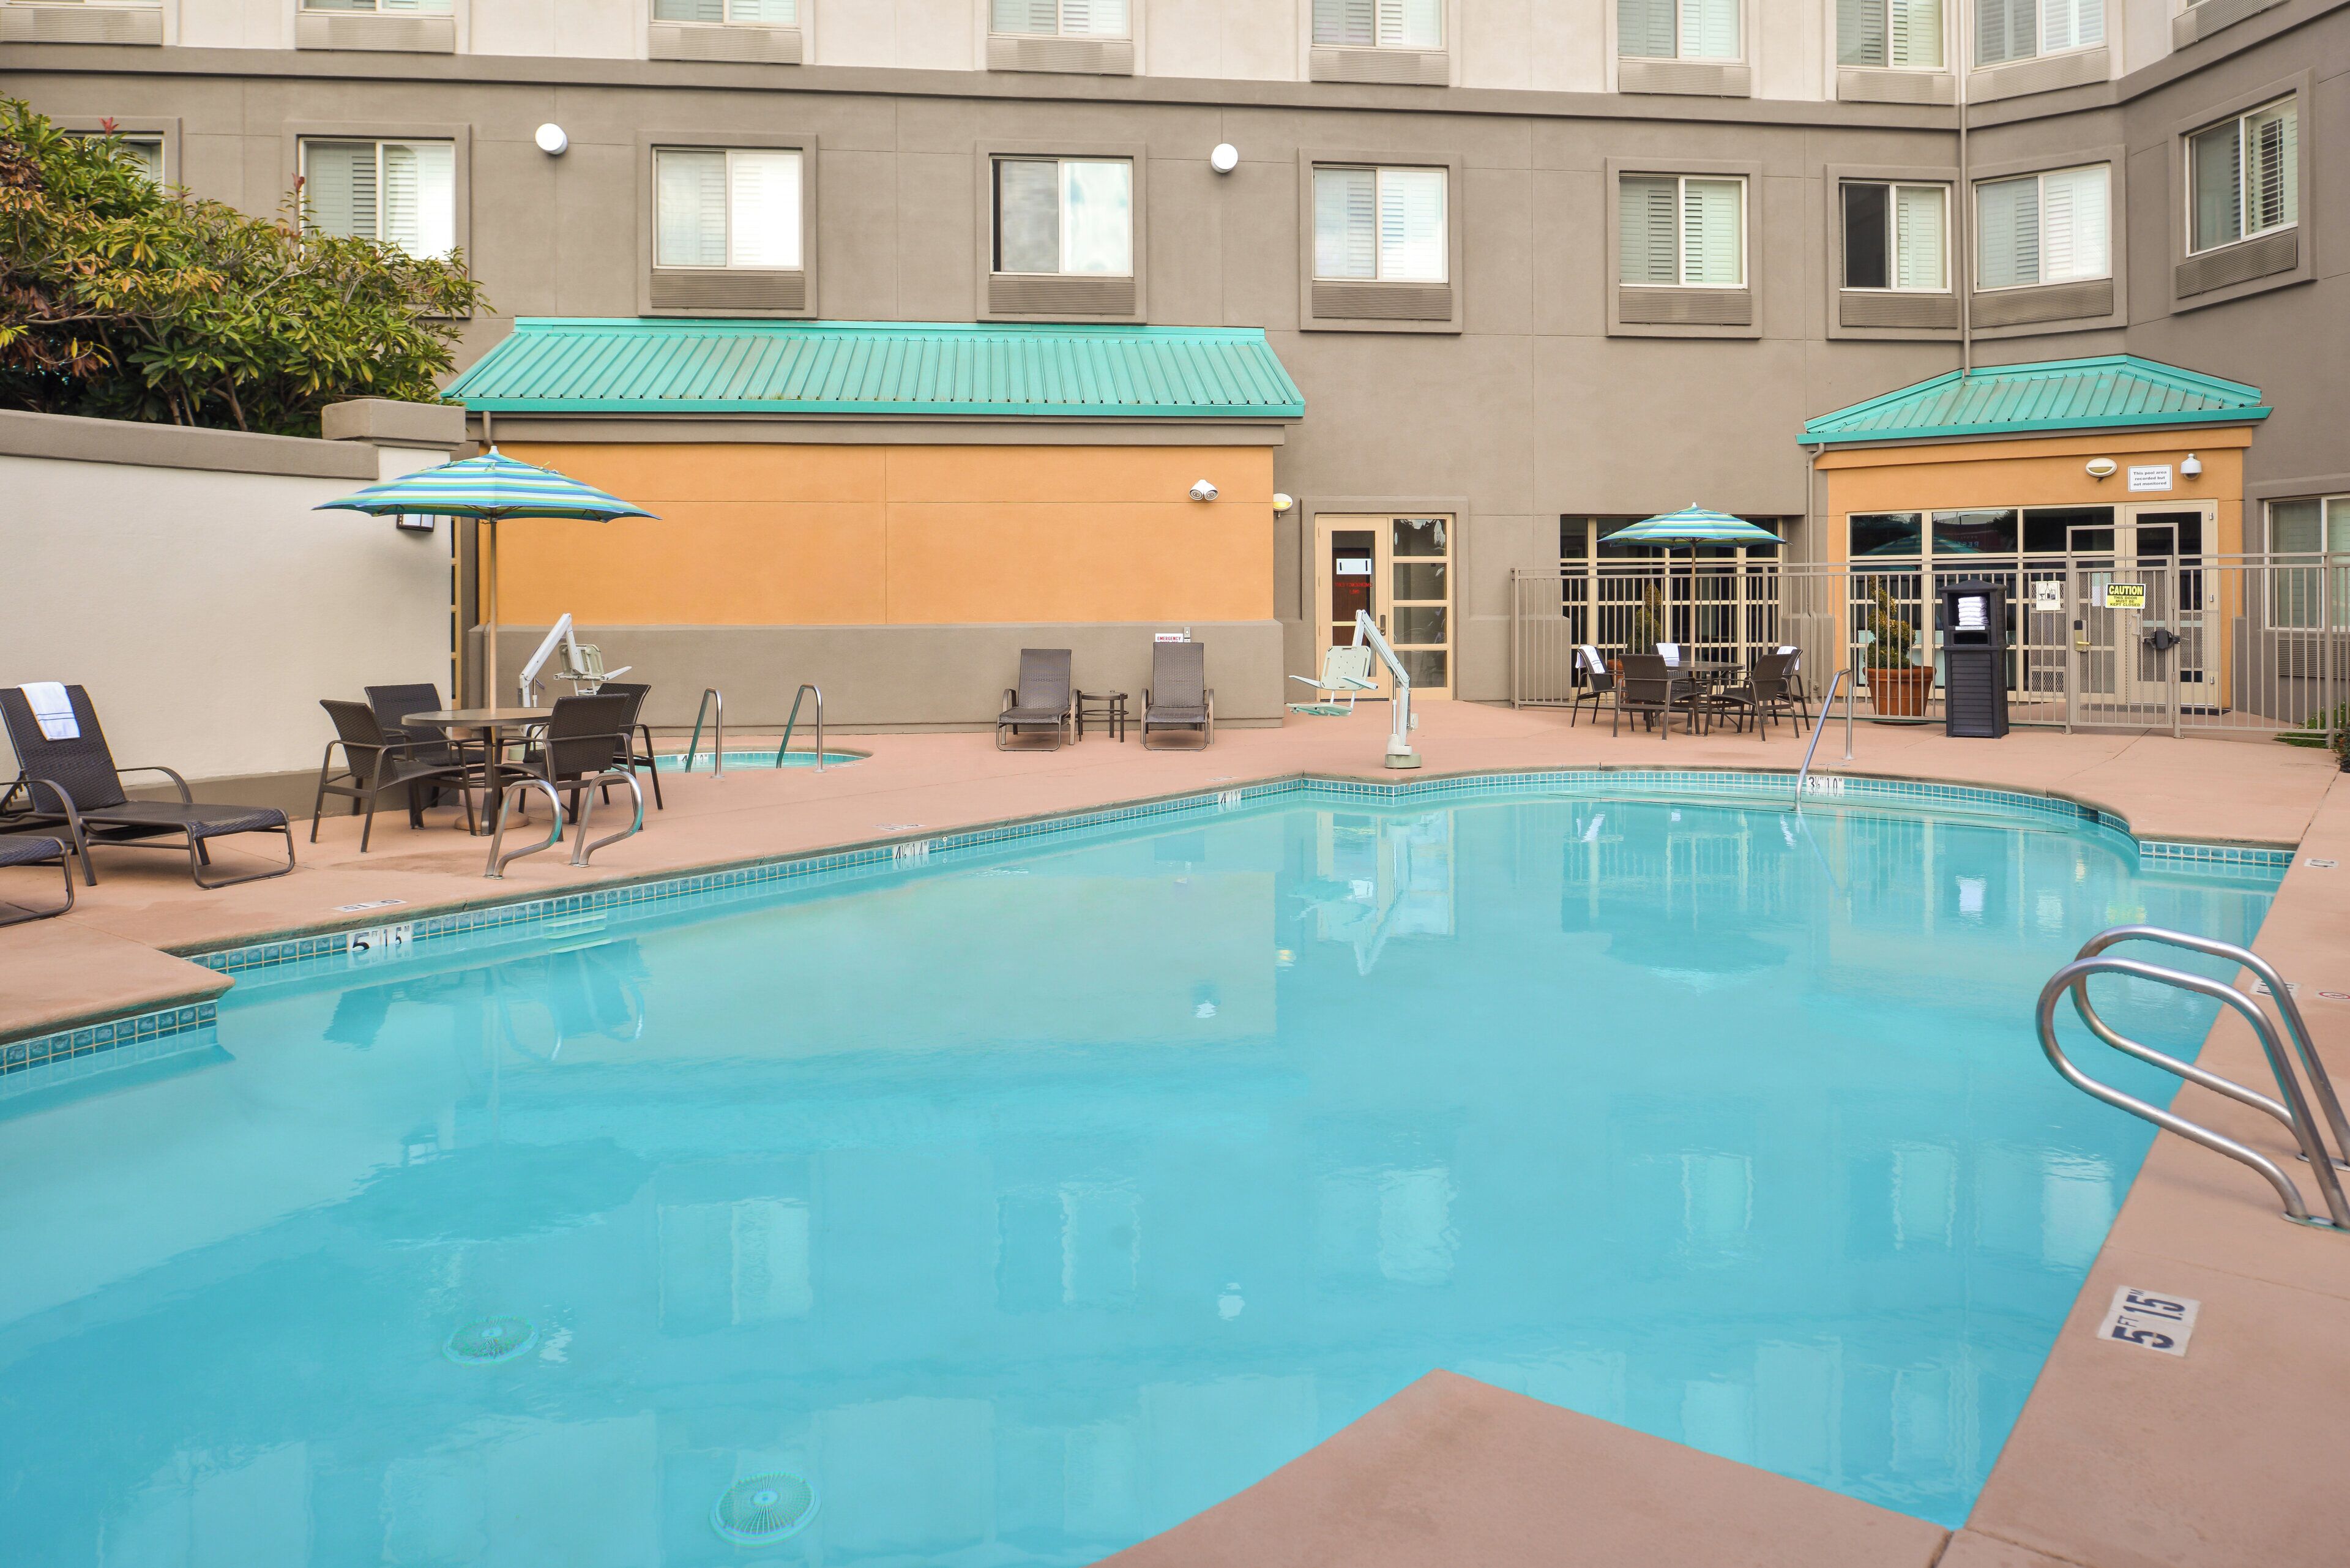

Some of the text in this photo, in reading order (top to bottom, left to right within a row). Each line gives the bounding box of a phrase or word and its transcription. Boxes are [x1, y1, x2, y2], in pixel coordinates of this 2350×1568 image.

[2109, 585, 2143, 595] CAUTION
[352, 931, 370, 952] 5
[2116, 1315, 2139, 1327] FT
[2111, 1325, 2174, 1349] 5
